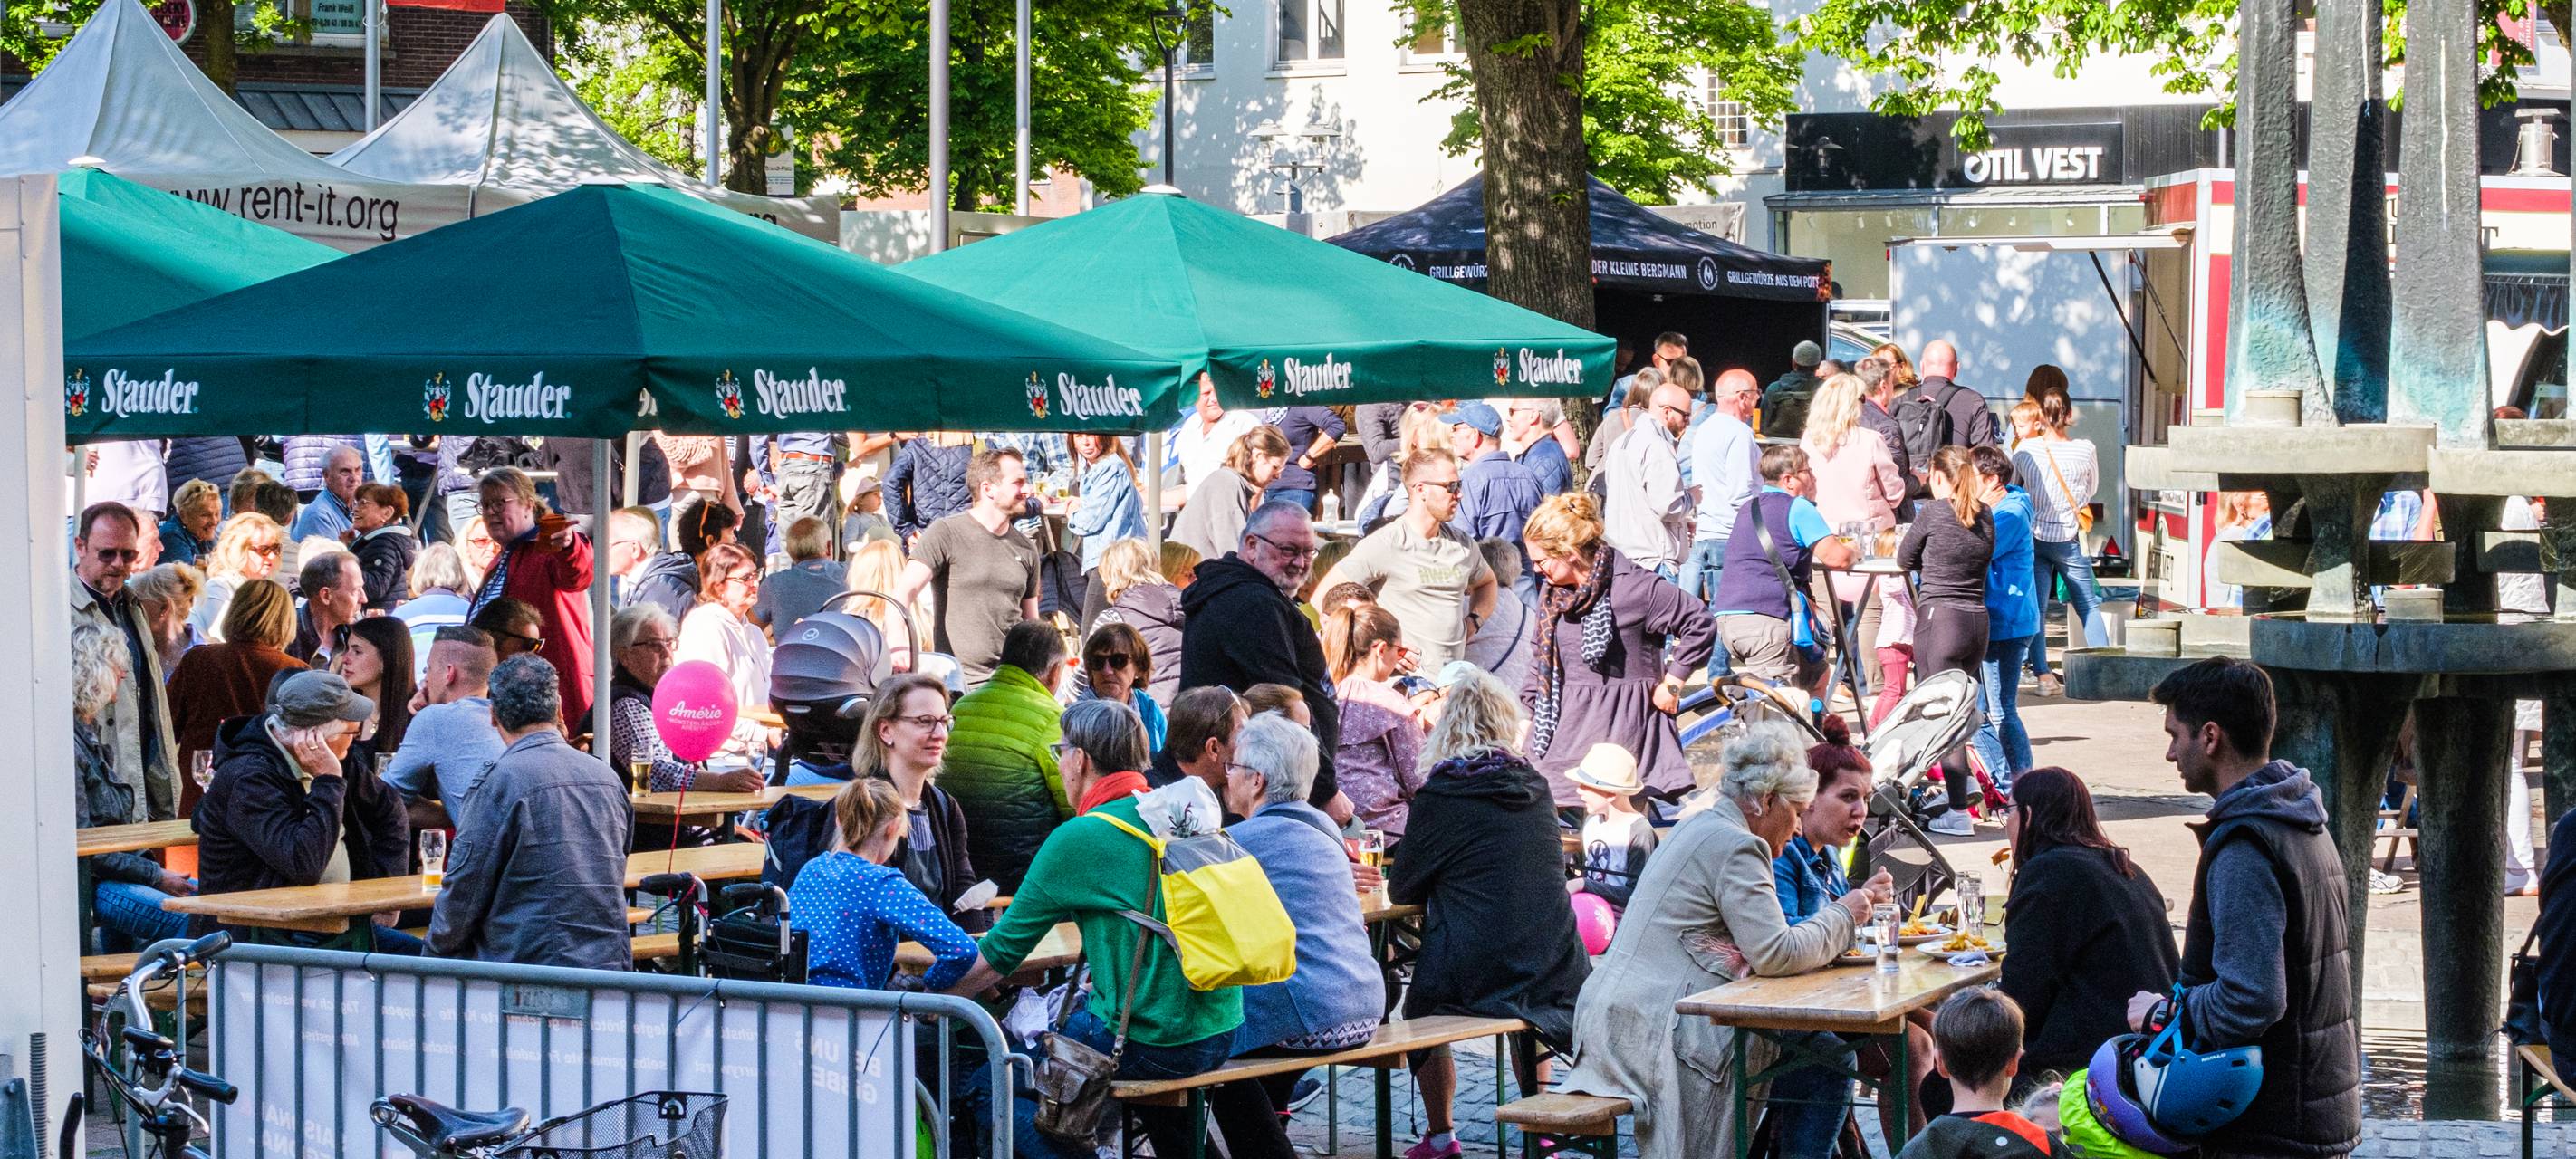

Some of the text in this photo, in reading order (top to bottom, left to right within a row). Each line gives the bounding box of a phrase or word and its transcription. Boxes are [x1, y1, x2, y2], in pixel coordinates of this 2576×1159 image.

[317, 3, 337, 13] Frank
[2032, 147, 2103, 180] VEST
[1591, 259, 1609, 274] DER
[1610, 261, 1639, 276] KLEINE
[1640, 263, 1687, 280] BERGMANN
[1727, 270, 1820, 289] GRILLGEWÜRZE AUS DEM POTT
[1284, 352, 1353, 398] Stauder
[1519, 348, 1583, 388] Stauder
[101, 368, 198, 418] Stauder
[464, 371, 572, 424] Stauder
[754, 367, 847, 419] Stauder
[1058, 372, 1144, 420] Stauder
[668, 700, 723, 719] Amérie
